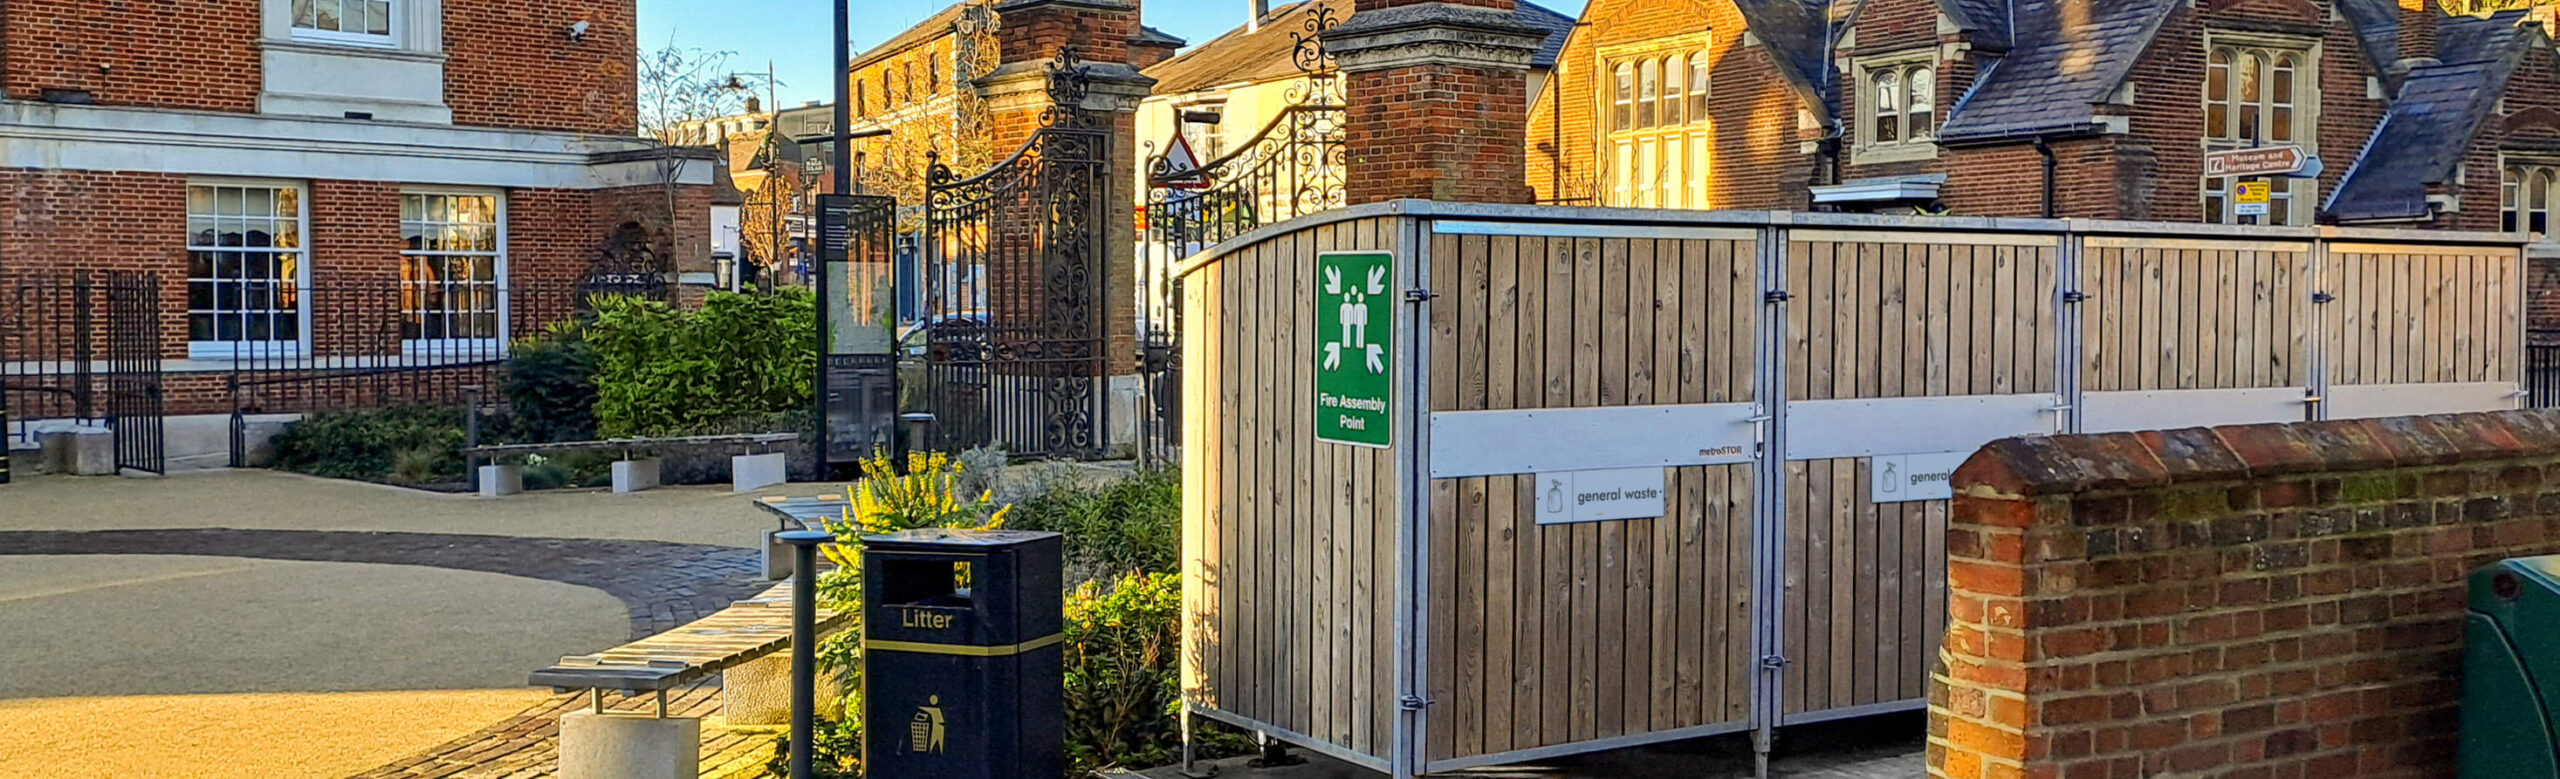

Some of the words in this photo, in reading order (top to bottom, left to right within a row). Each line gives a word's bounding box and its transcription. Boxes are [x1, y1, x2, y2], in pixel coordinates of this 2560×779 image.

[2231, 153, 2265, 163] Museum
[2268, 152, 2284, 160] and
[2225, 164, 2261, 173] Heritage
[2262, 160, 2291, 169] Centre
[1320, 392, 1338, 407] Fire
[1339, 394, 1386, 414] Assembly
[1340, 414, 1365, 430] Point
[1699, 445, 1743, 457] metroSTOR
[1910, 468, 1950, 485] general
[1577, 487, 1622, 506] general
[1624, 487, 1658, 500] waste
[902, 609, 953, 629] Litter
